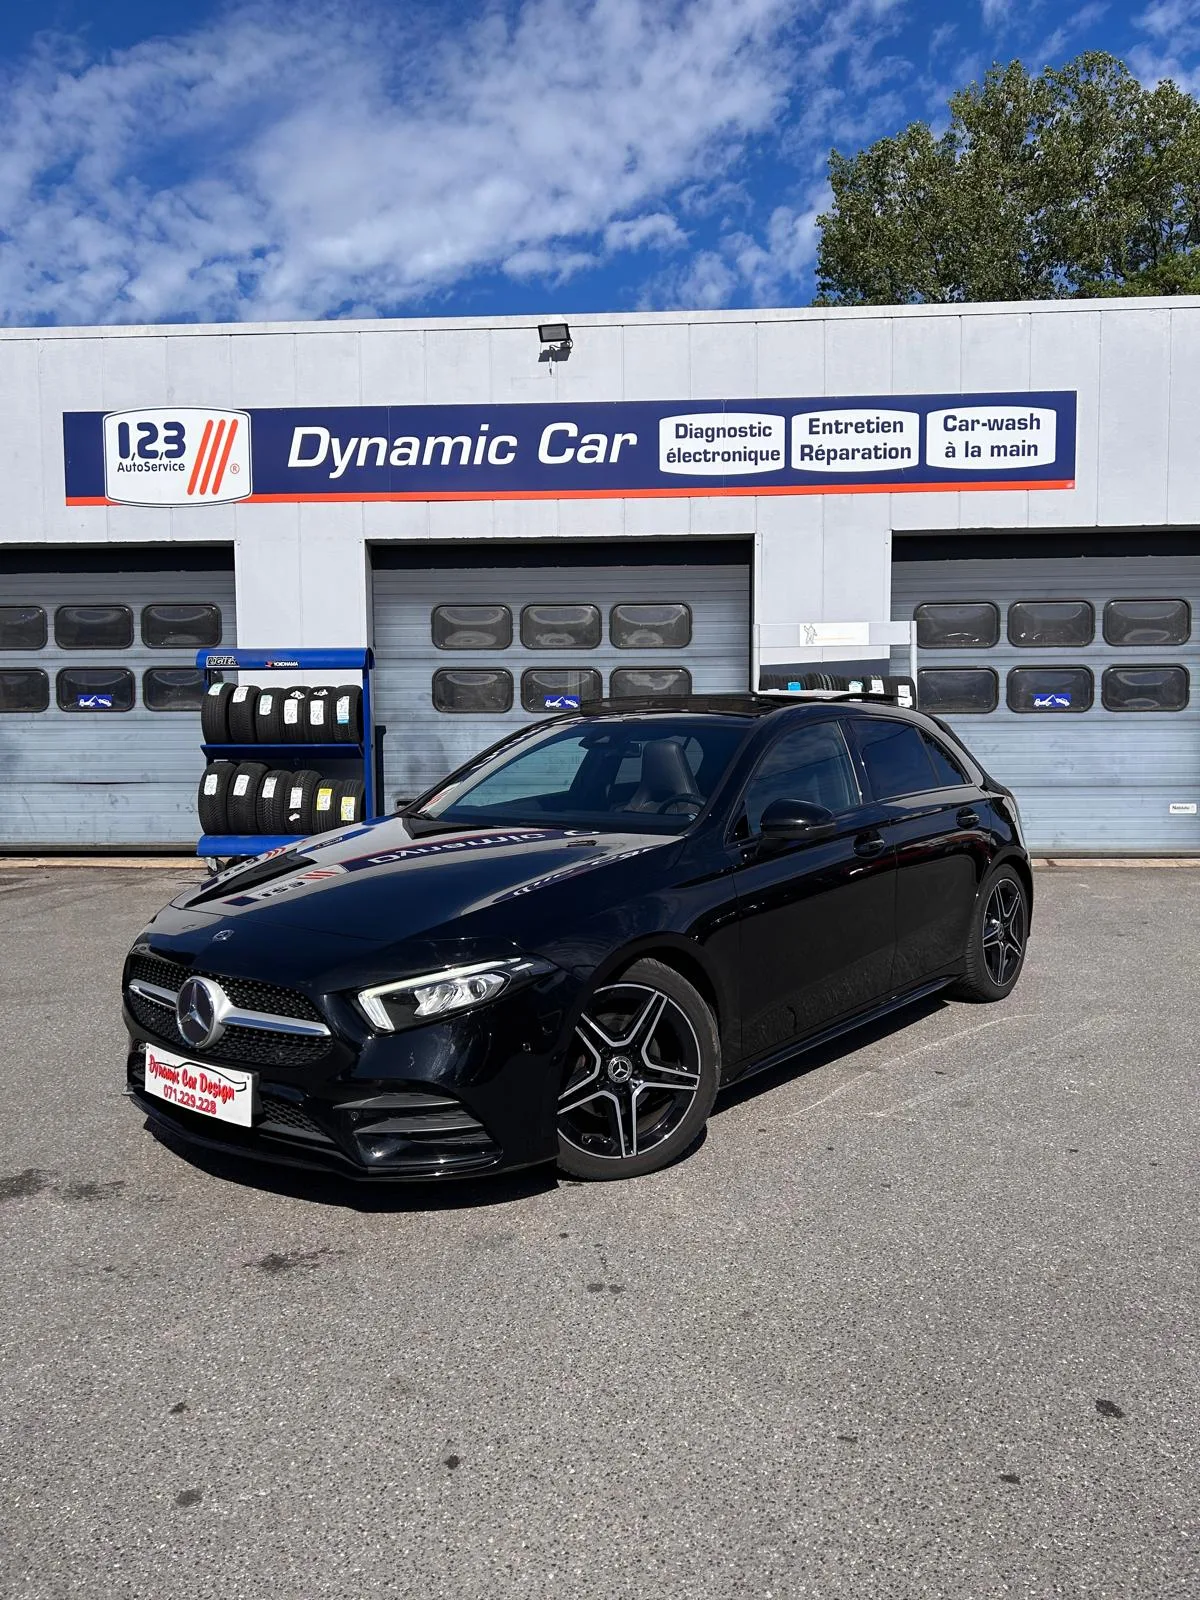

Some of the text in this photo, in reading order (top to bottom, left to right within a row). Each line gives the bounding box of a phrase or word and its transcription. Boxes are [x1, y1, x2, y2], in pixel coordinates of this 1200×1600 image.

[675, 421, 773, 442] Diagnostic
[808, 416, 904, 435] Entretien
[943, 413, 1041, 432] Car-wash
[288, 422, 637, 479] Dynamic Car
[666, 446, 781, 465] électronique
[799, 443, 912, 465] Réparation
[944, 440, 1039, 459] à la main
[117, 461, 186, 473] AutoService
[148, 1054, 235, 1104] Dynamic Car Design
[163, 1085, 217, 1115] 071.229.228
